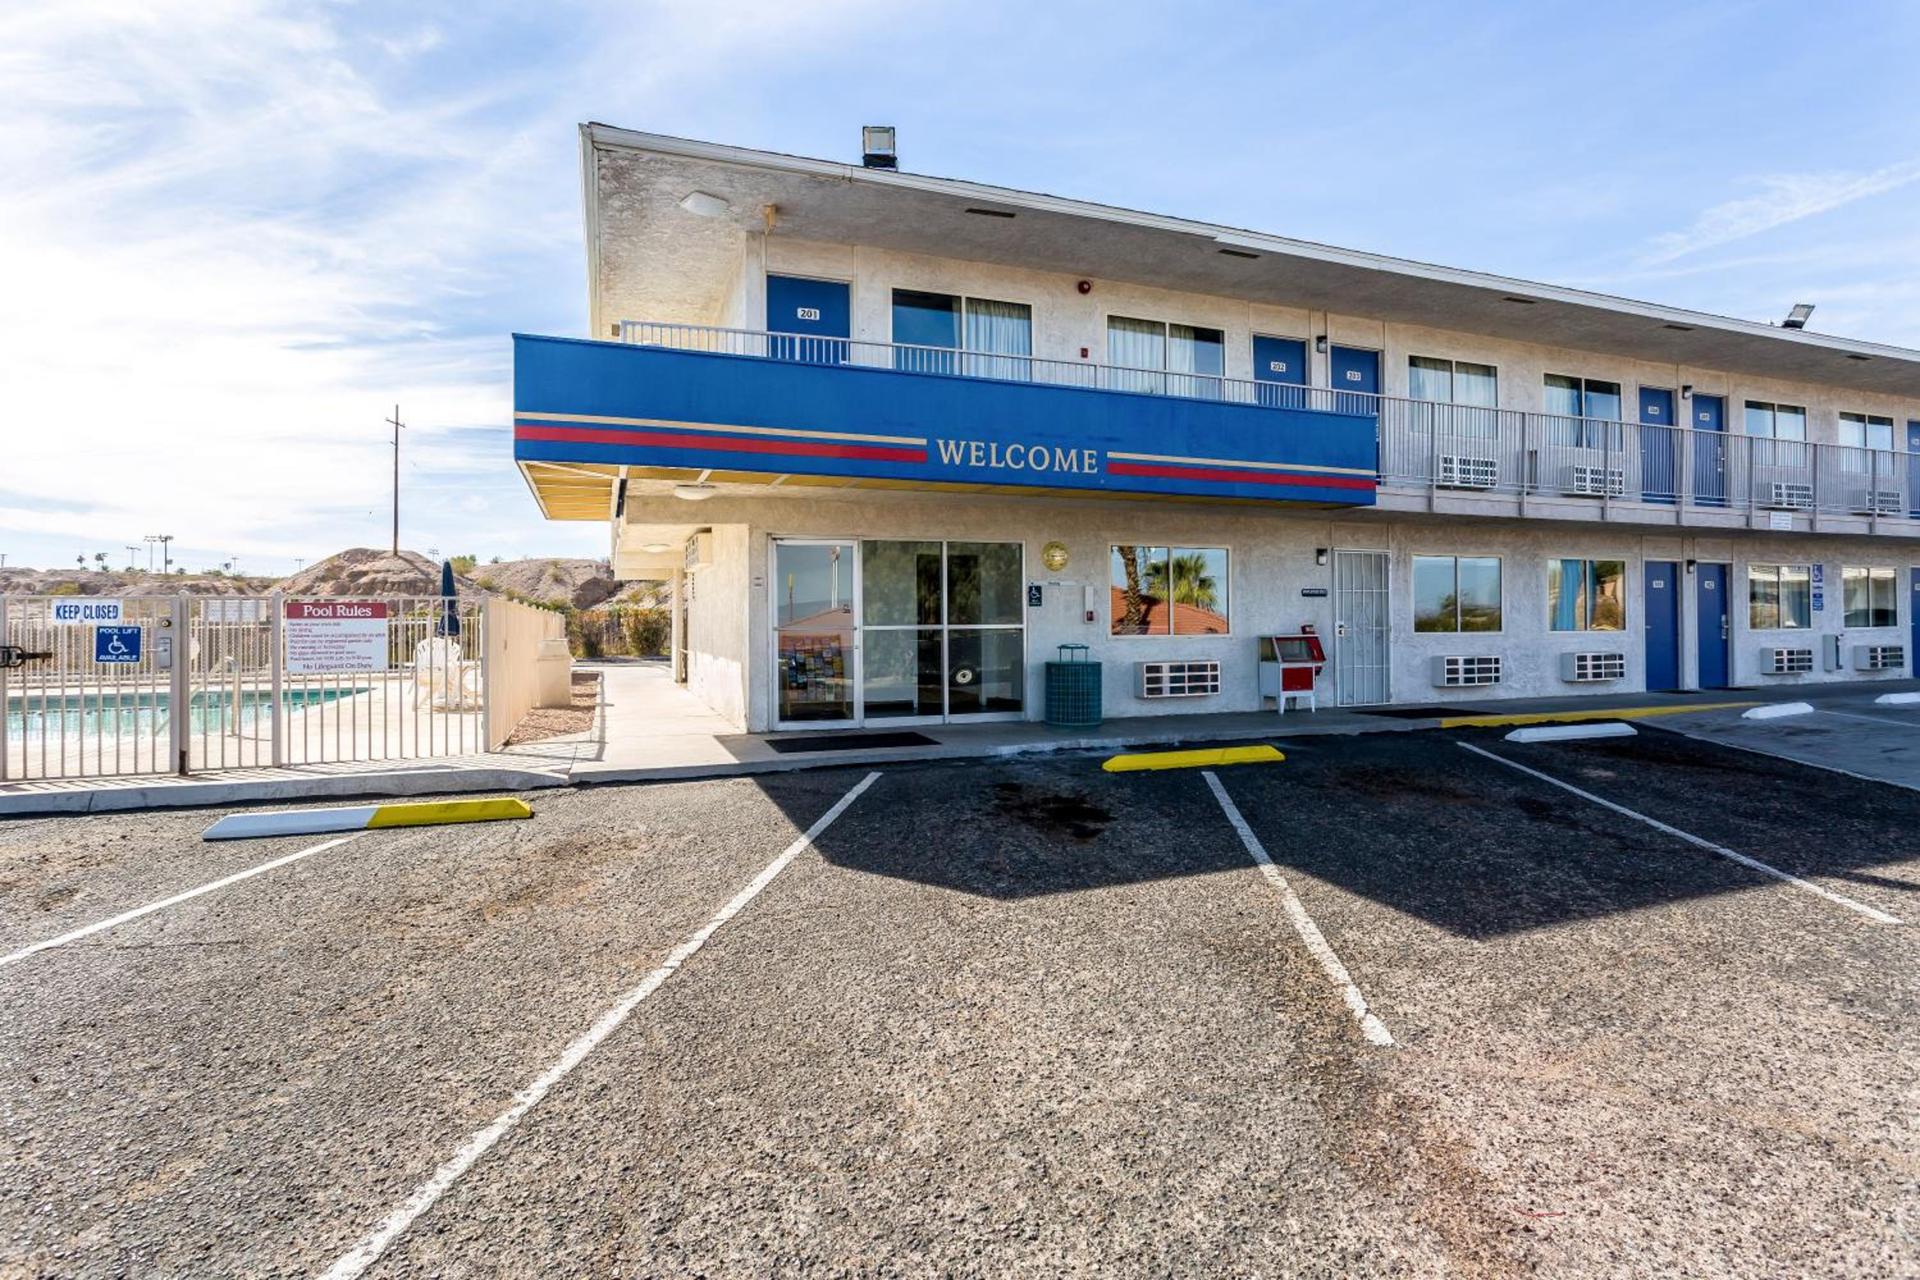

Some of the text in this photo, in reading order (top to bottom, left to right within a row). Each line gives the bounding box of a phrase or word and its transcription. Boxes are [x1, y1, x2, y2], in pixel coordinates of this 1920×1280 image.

[800, 309, 818, 319] 201
[937, 439, 1099, 474] WELCOME
[56, 605, 119, 619] KEEP CLOSED
[303, 605, 372, 617] Pool Rules
